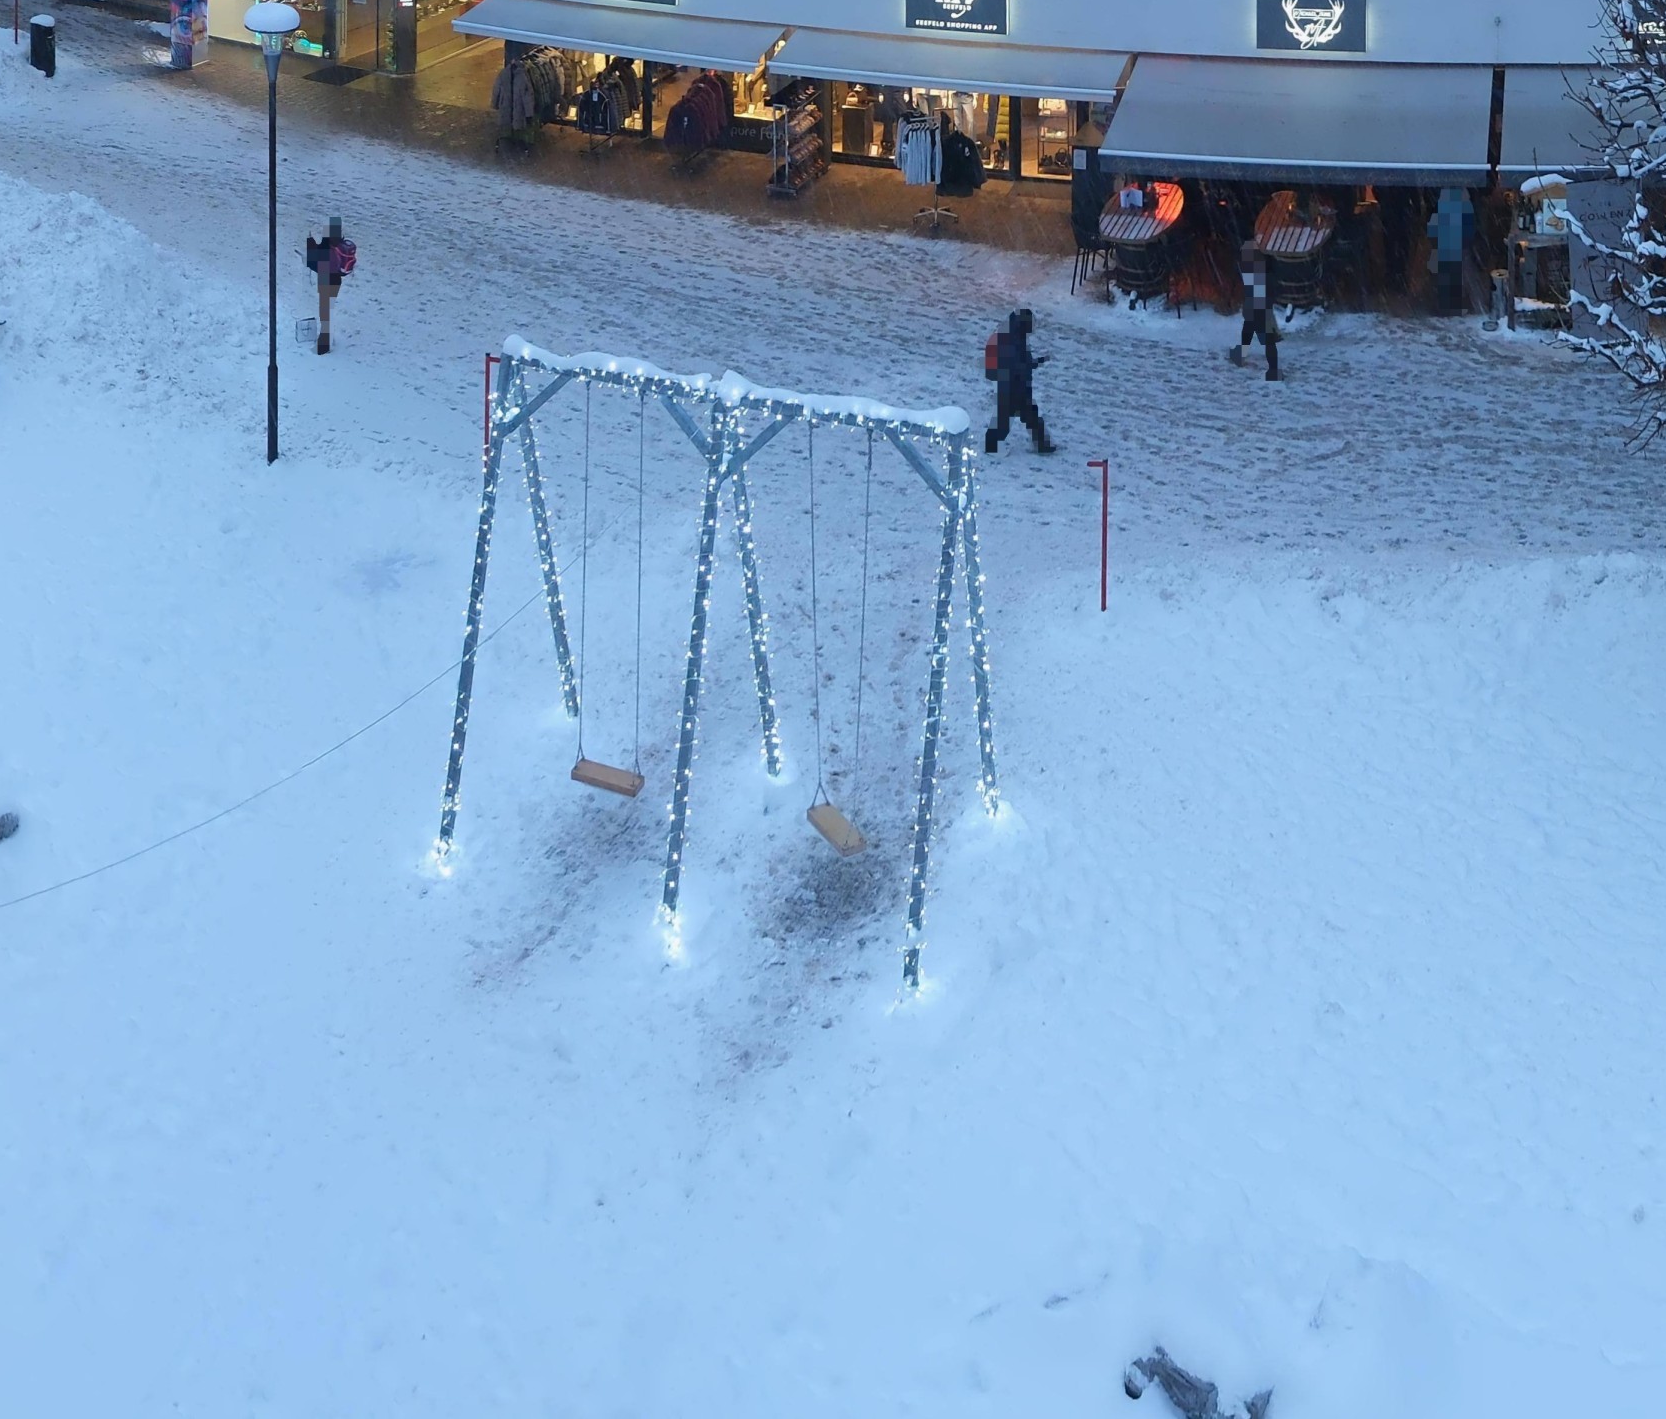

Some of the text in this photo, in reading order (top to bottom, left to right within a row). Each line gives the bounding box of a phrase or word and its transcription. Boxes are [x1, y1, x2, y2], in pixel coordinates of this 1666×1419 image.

[943, 3, 972, 11] SEEFELD
[915, 19, 945, 28] SEEFELD
[946, 21, 982, 30] SHOPPING
